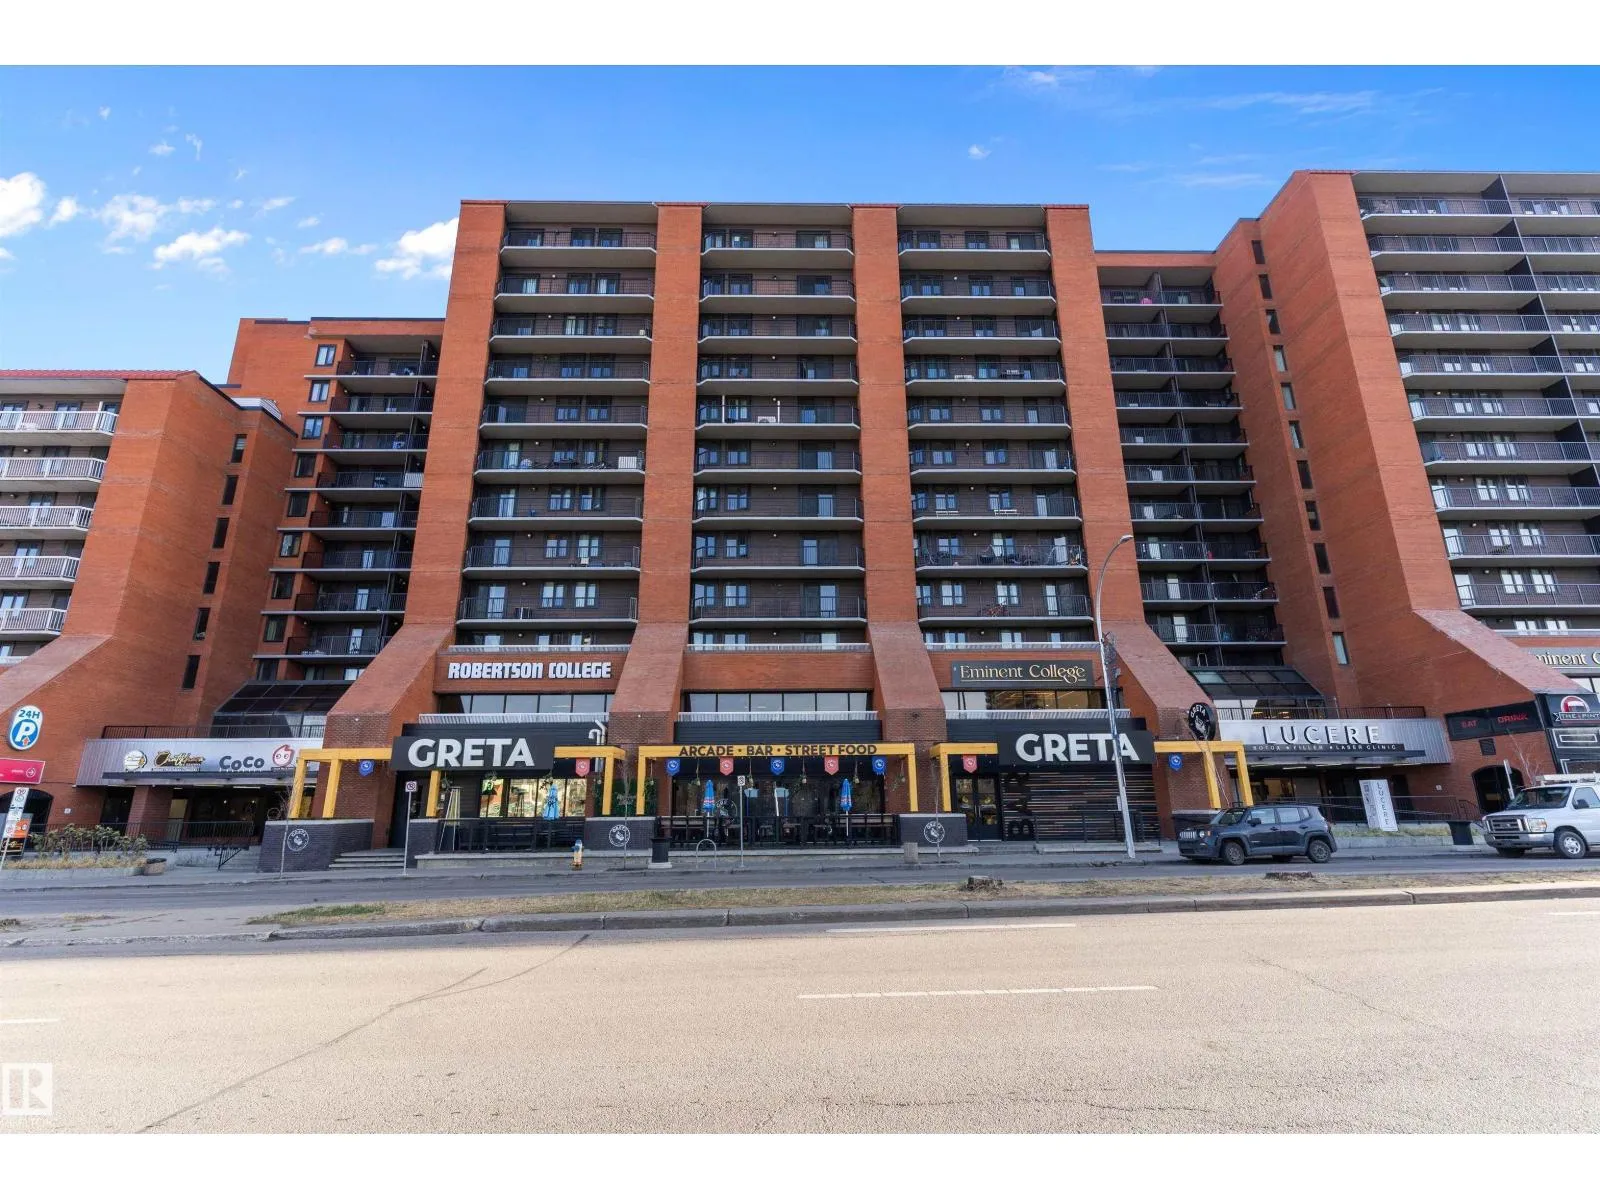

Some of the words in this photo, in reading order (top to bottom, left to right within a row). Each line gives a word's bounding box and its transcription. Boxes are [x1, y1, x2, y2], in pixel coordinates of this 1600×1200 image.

[448, 662, 543, 679] ROBERTSON
[549, 662, 612, 679] COLLEGE
[960, 665, 1023, 679] Eminent
[1029, 664, 1086, 684] College
[18, 709, 41, 719] 24H
[1190, 704, 1207, 719] GRETA
[14, 721, 36, 742] P
[1262, 725, 1381, 744] LUCERE
[408, 738, 535, 768] GRETA
[679, 745, 734, 756] ARCADE
[746, 745, 773, 756] BAR
[784, 744, 835, 756] STREET
[838, 744, 877, 755] FOOD
[1015, 733, 1140, 762] GRETA
